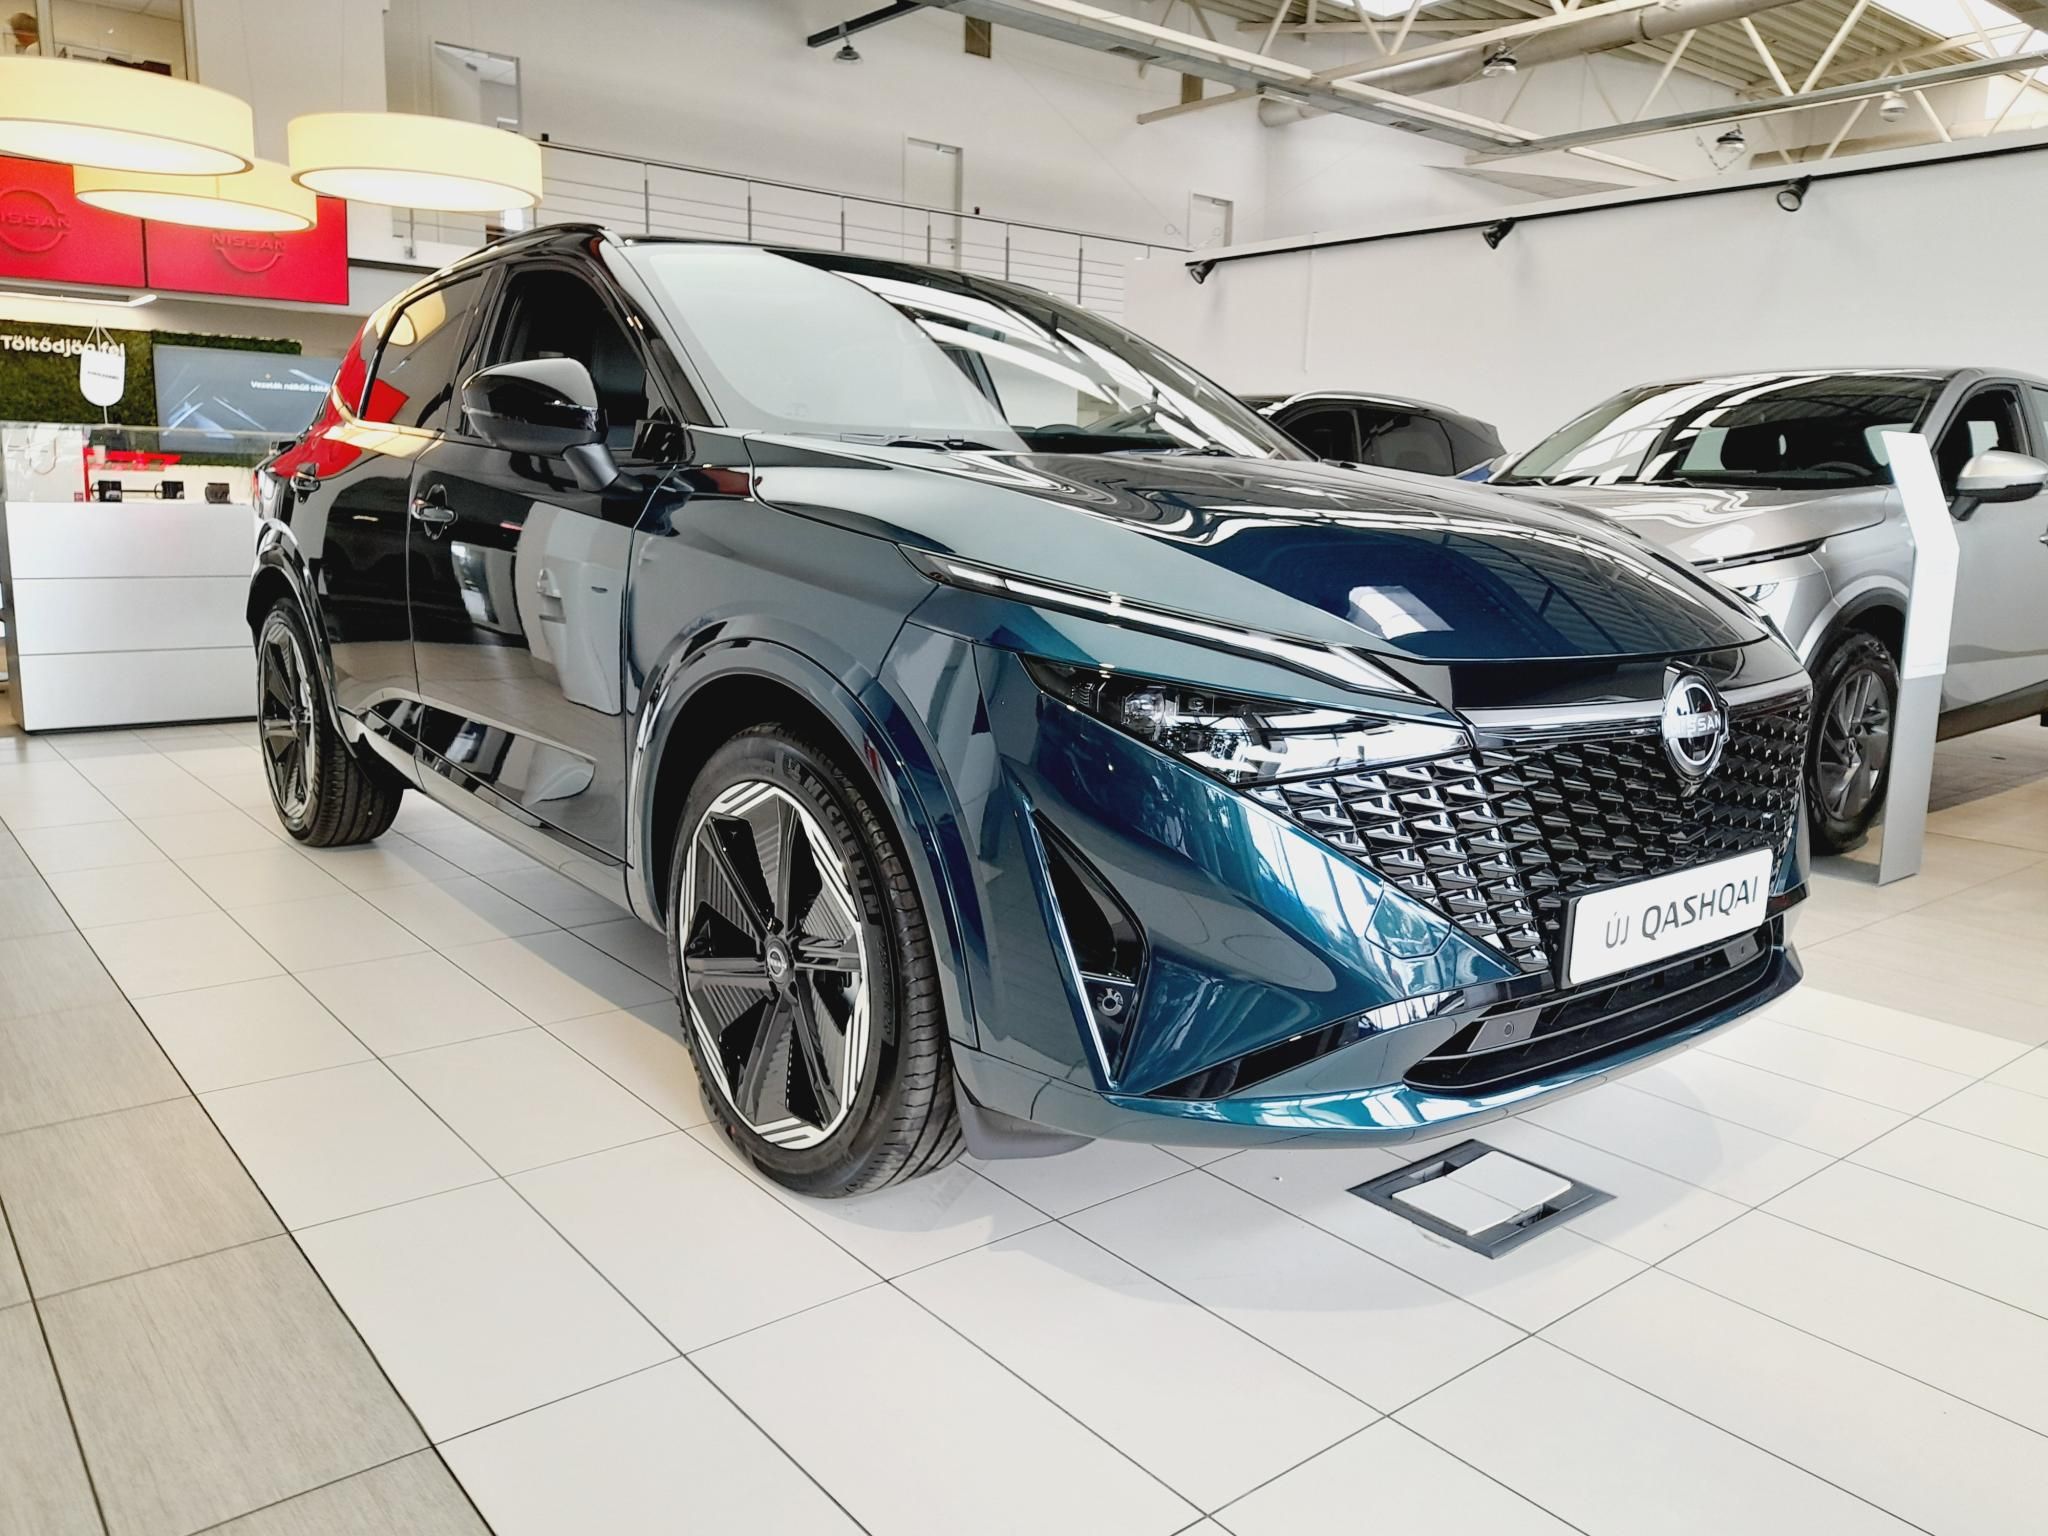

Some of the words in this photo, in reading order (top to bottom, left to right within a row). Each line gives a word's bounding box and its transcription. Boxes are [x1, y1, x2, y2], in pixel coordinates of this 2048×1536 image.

[0, 212, 71, 229] ISSAN
[211, 231, 286, 250] NISSAN
[803, 776, 880, 915] MICHELIN
[1605, 911, 1630, 949] ÚJ
[1641, 875, 1758, 941] QASHQAI
